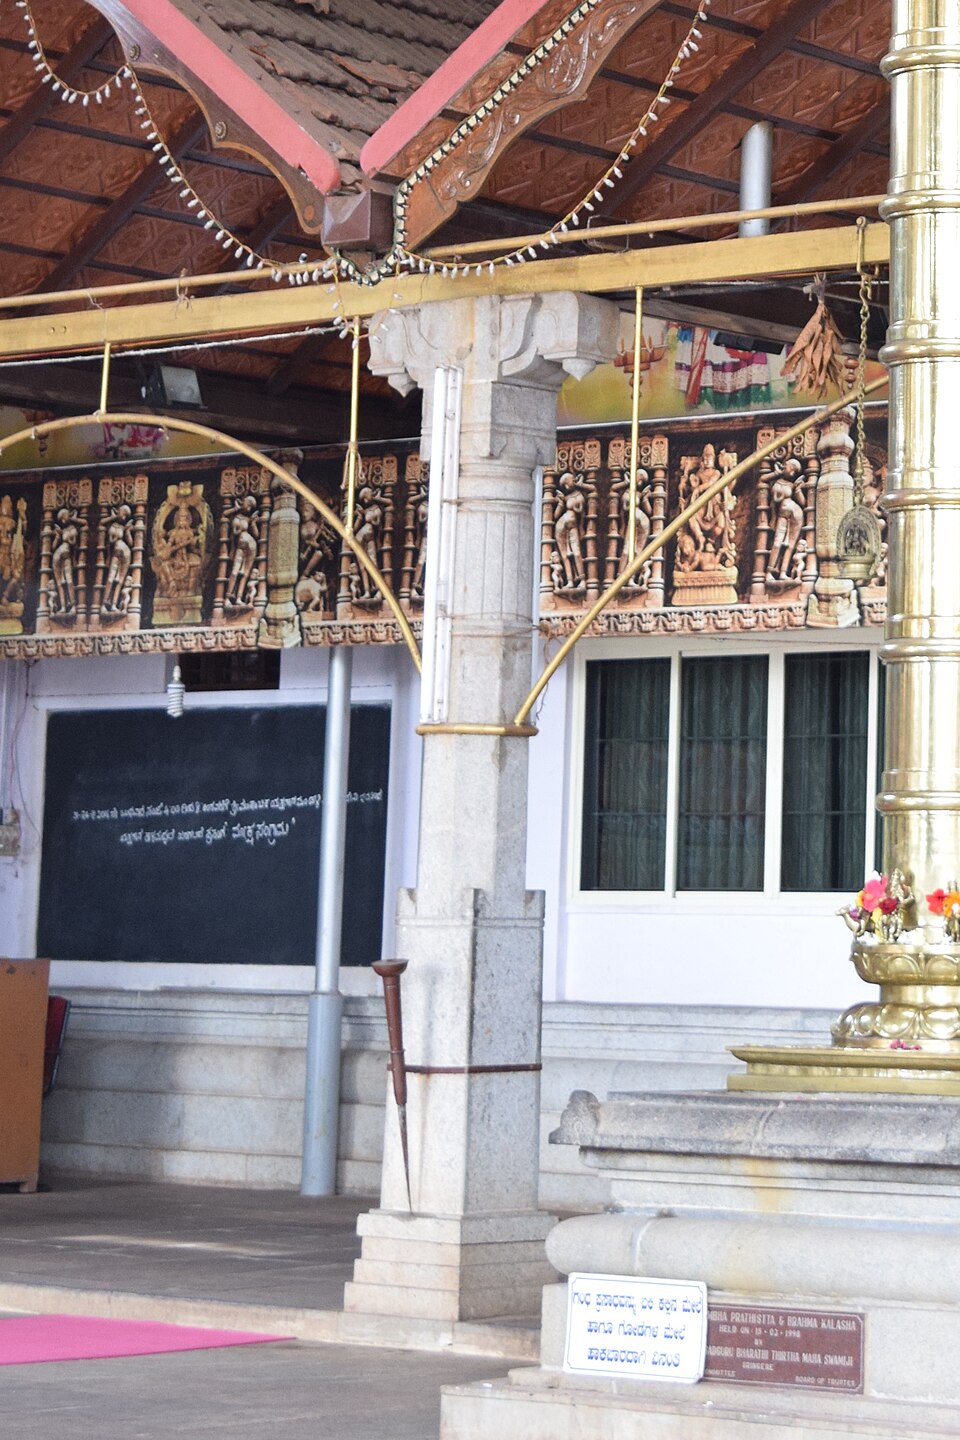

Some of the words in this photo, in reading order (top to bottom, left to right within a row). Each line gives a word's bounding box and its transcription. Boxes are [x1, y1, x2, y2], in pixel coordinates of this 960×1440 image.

[719, 1324, 737, 1333] HELD
[787, 1315, 818, 1328] BRAHMA
[820, 1318, 857, 1331] KALASHA
[736, 1347, 769, 1360] BHARATHI
[802, 1352, 822, 1364] MAHA
[824, 1354, 854, 1366] SWAMIJI
